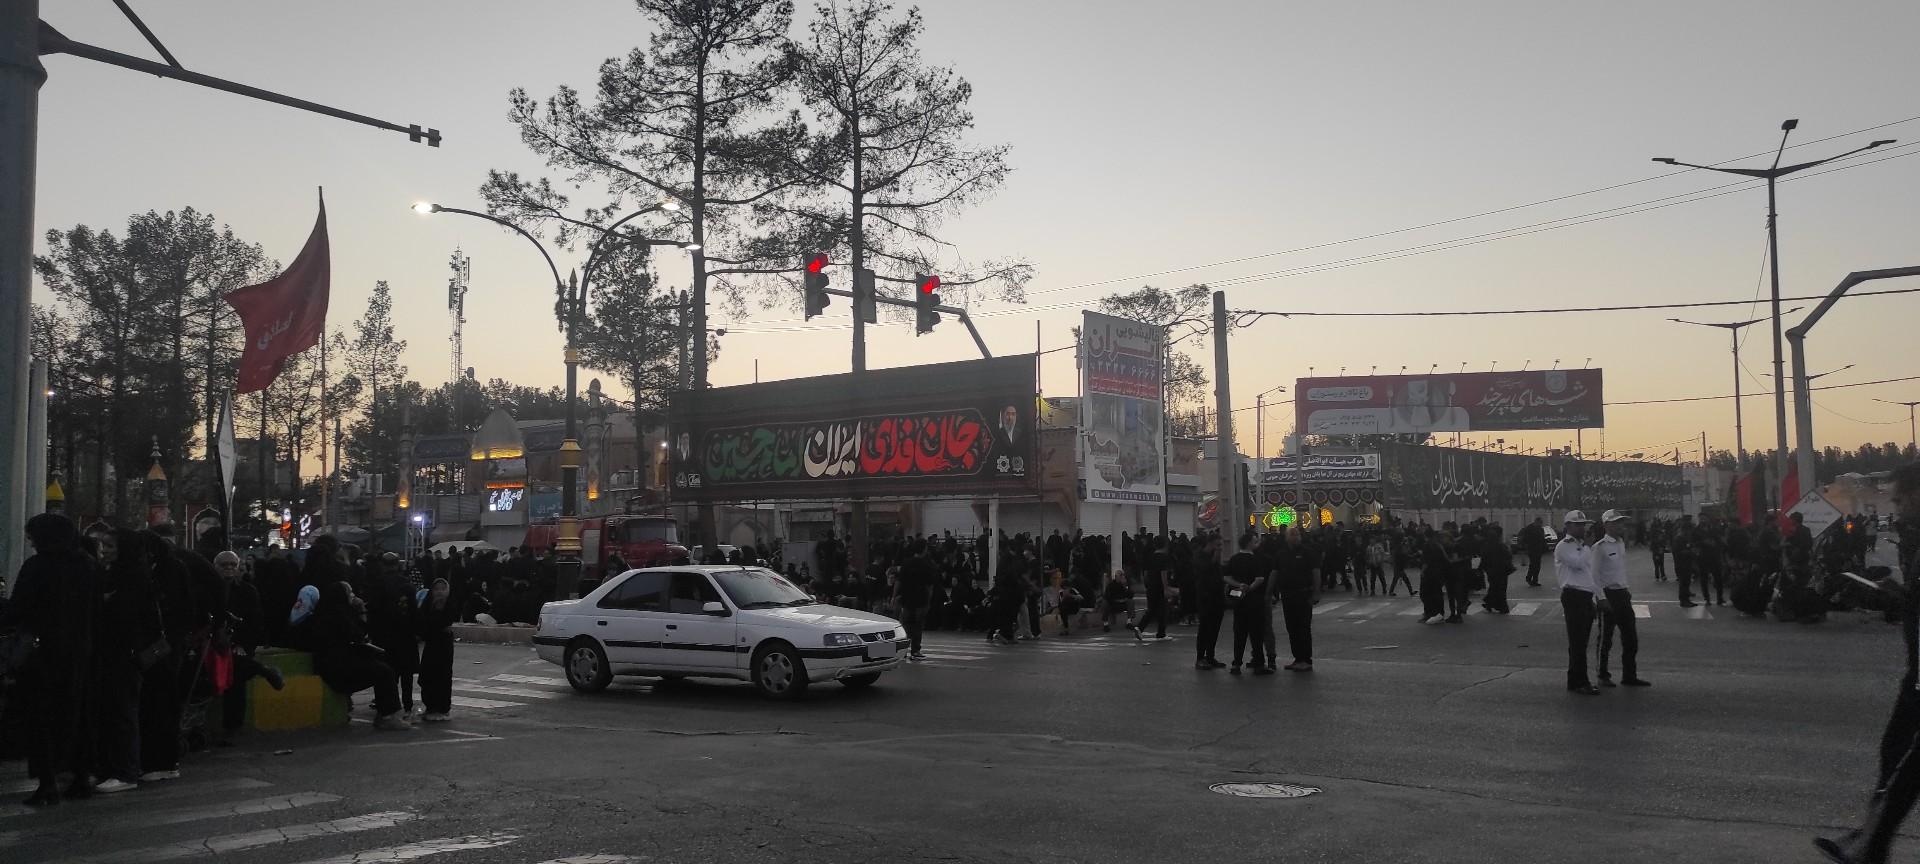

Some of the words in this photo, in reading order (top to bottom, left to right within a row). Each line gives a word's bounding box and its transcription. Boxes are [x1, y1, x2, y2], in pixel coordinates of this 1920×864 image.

[804, 421, 862, 478] ایران
[861, 417, 916, 475] فدای
[915, 414, 981, 472] جان
